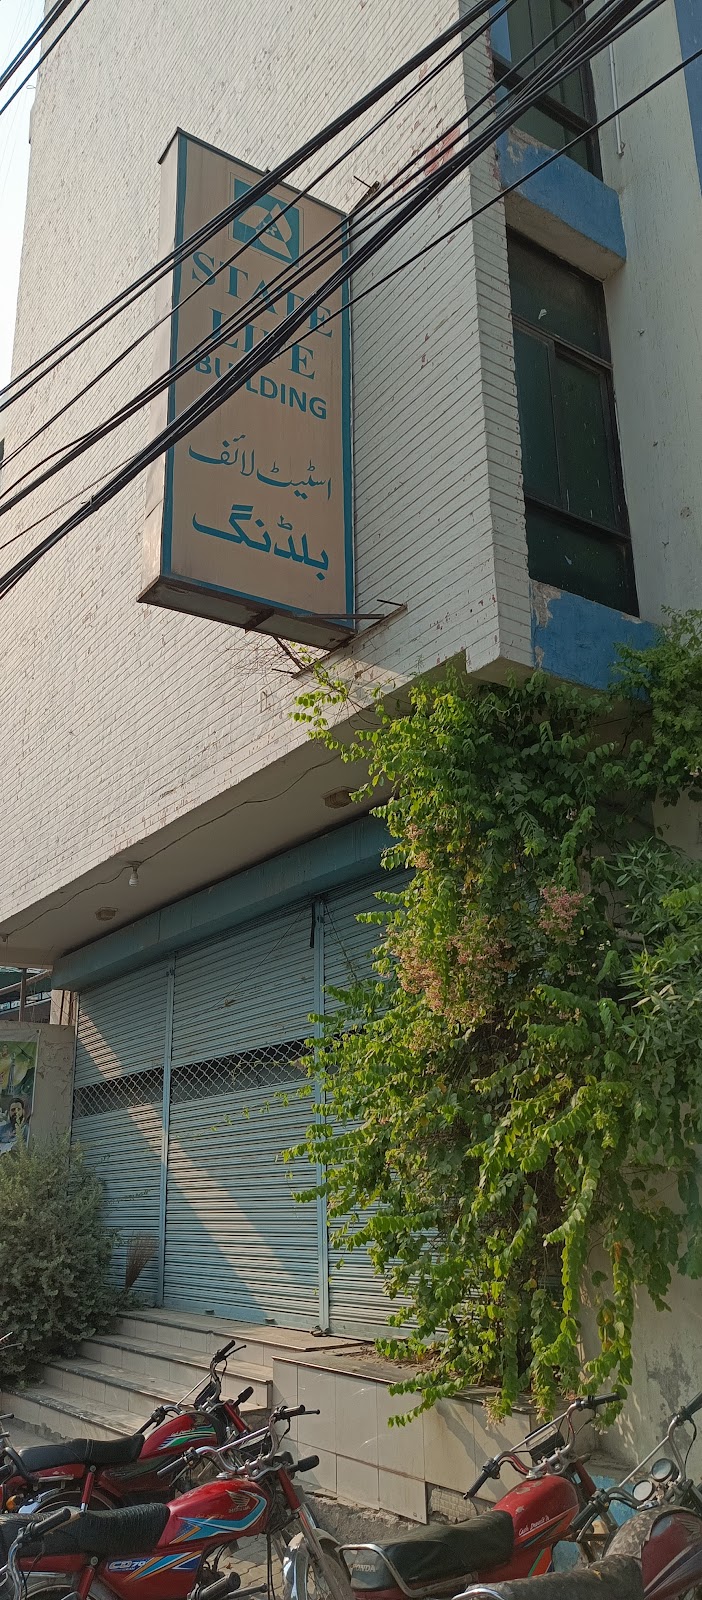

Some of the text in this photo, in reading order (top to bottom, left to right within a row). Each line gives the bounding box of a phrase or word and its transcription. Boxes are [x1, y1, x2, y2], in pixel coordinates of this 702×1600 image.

[209, 307, 316, 380] LIE
[195, 353, 327, 420] BULDING
[188, 433, 332, 501] اسٹیٹ لائف
[191, 503, 329, 581] بلڈنگ
